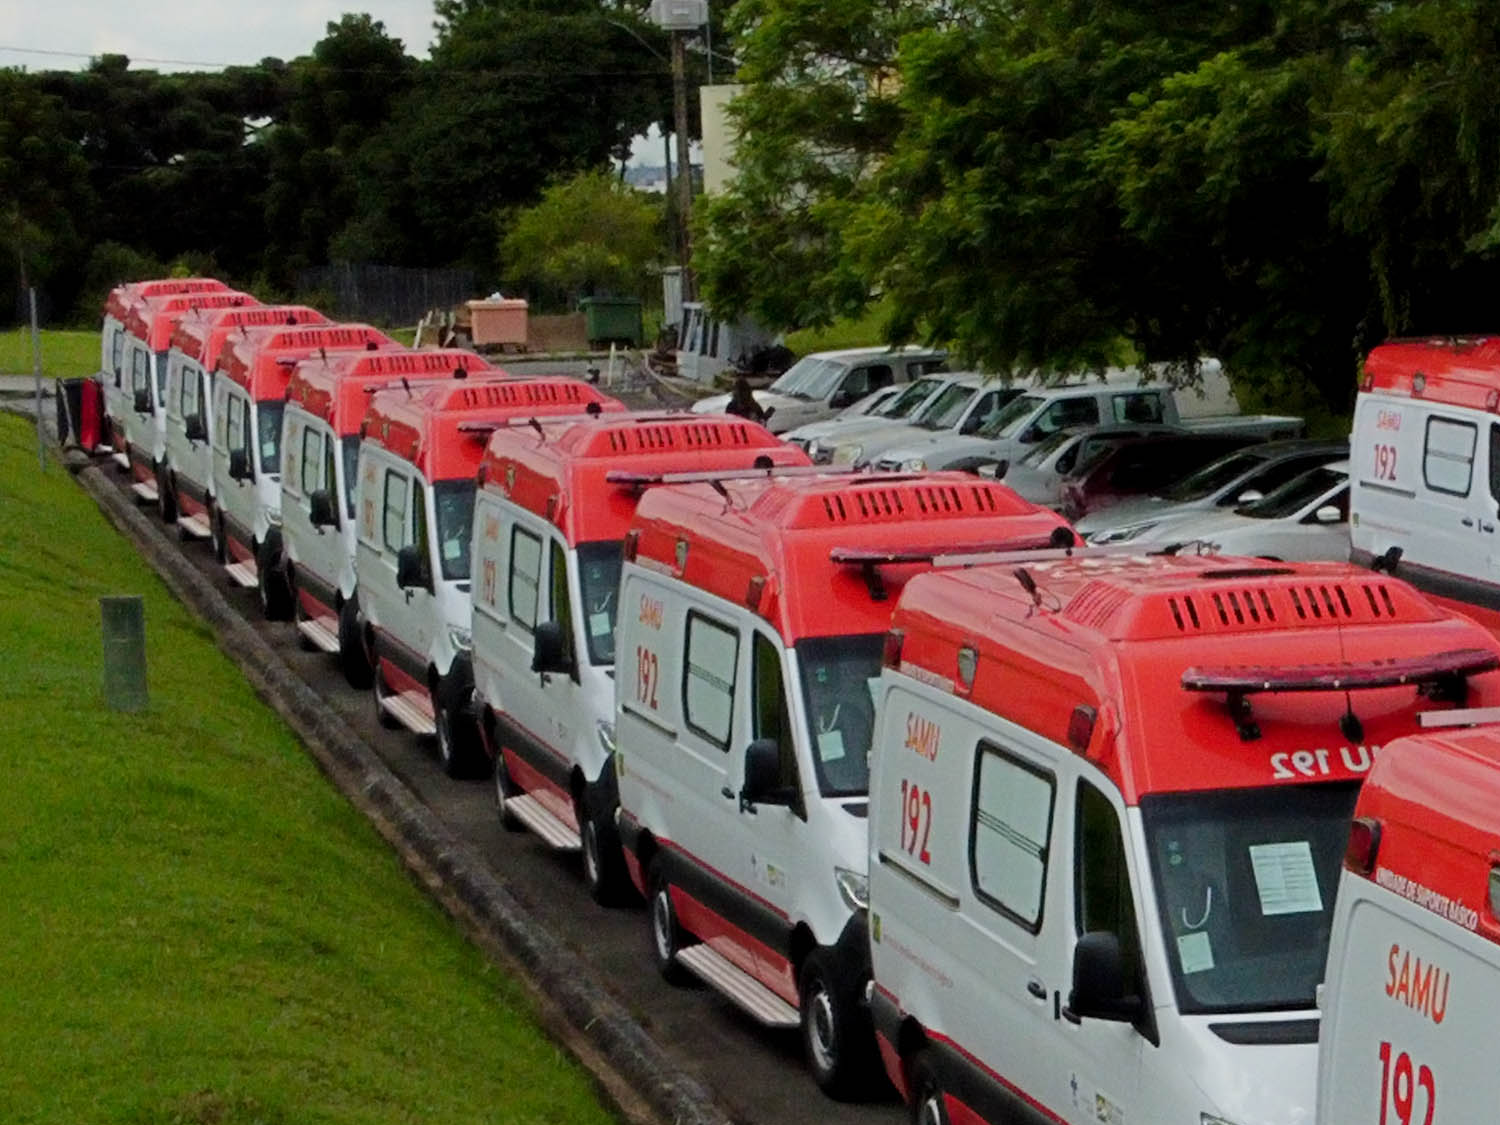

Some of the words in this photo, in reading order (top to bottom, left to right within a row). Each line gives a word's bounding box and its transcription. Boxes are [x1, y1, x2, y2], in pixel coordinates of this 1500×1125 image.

[1374, 444, 1397, 481] 192
[637, 645, 658, 710] 192
[905, 712, 941, 762] SAMU
[901, 779, 932, 866] 192
[1385, 944, 1450, 1025] SAMU
